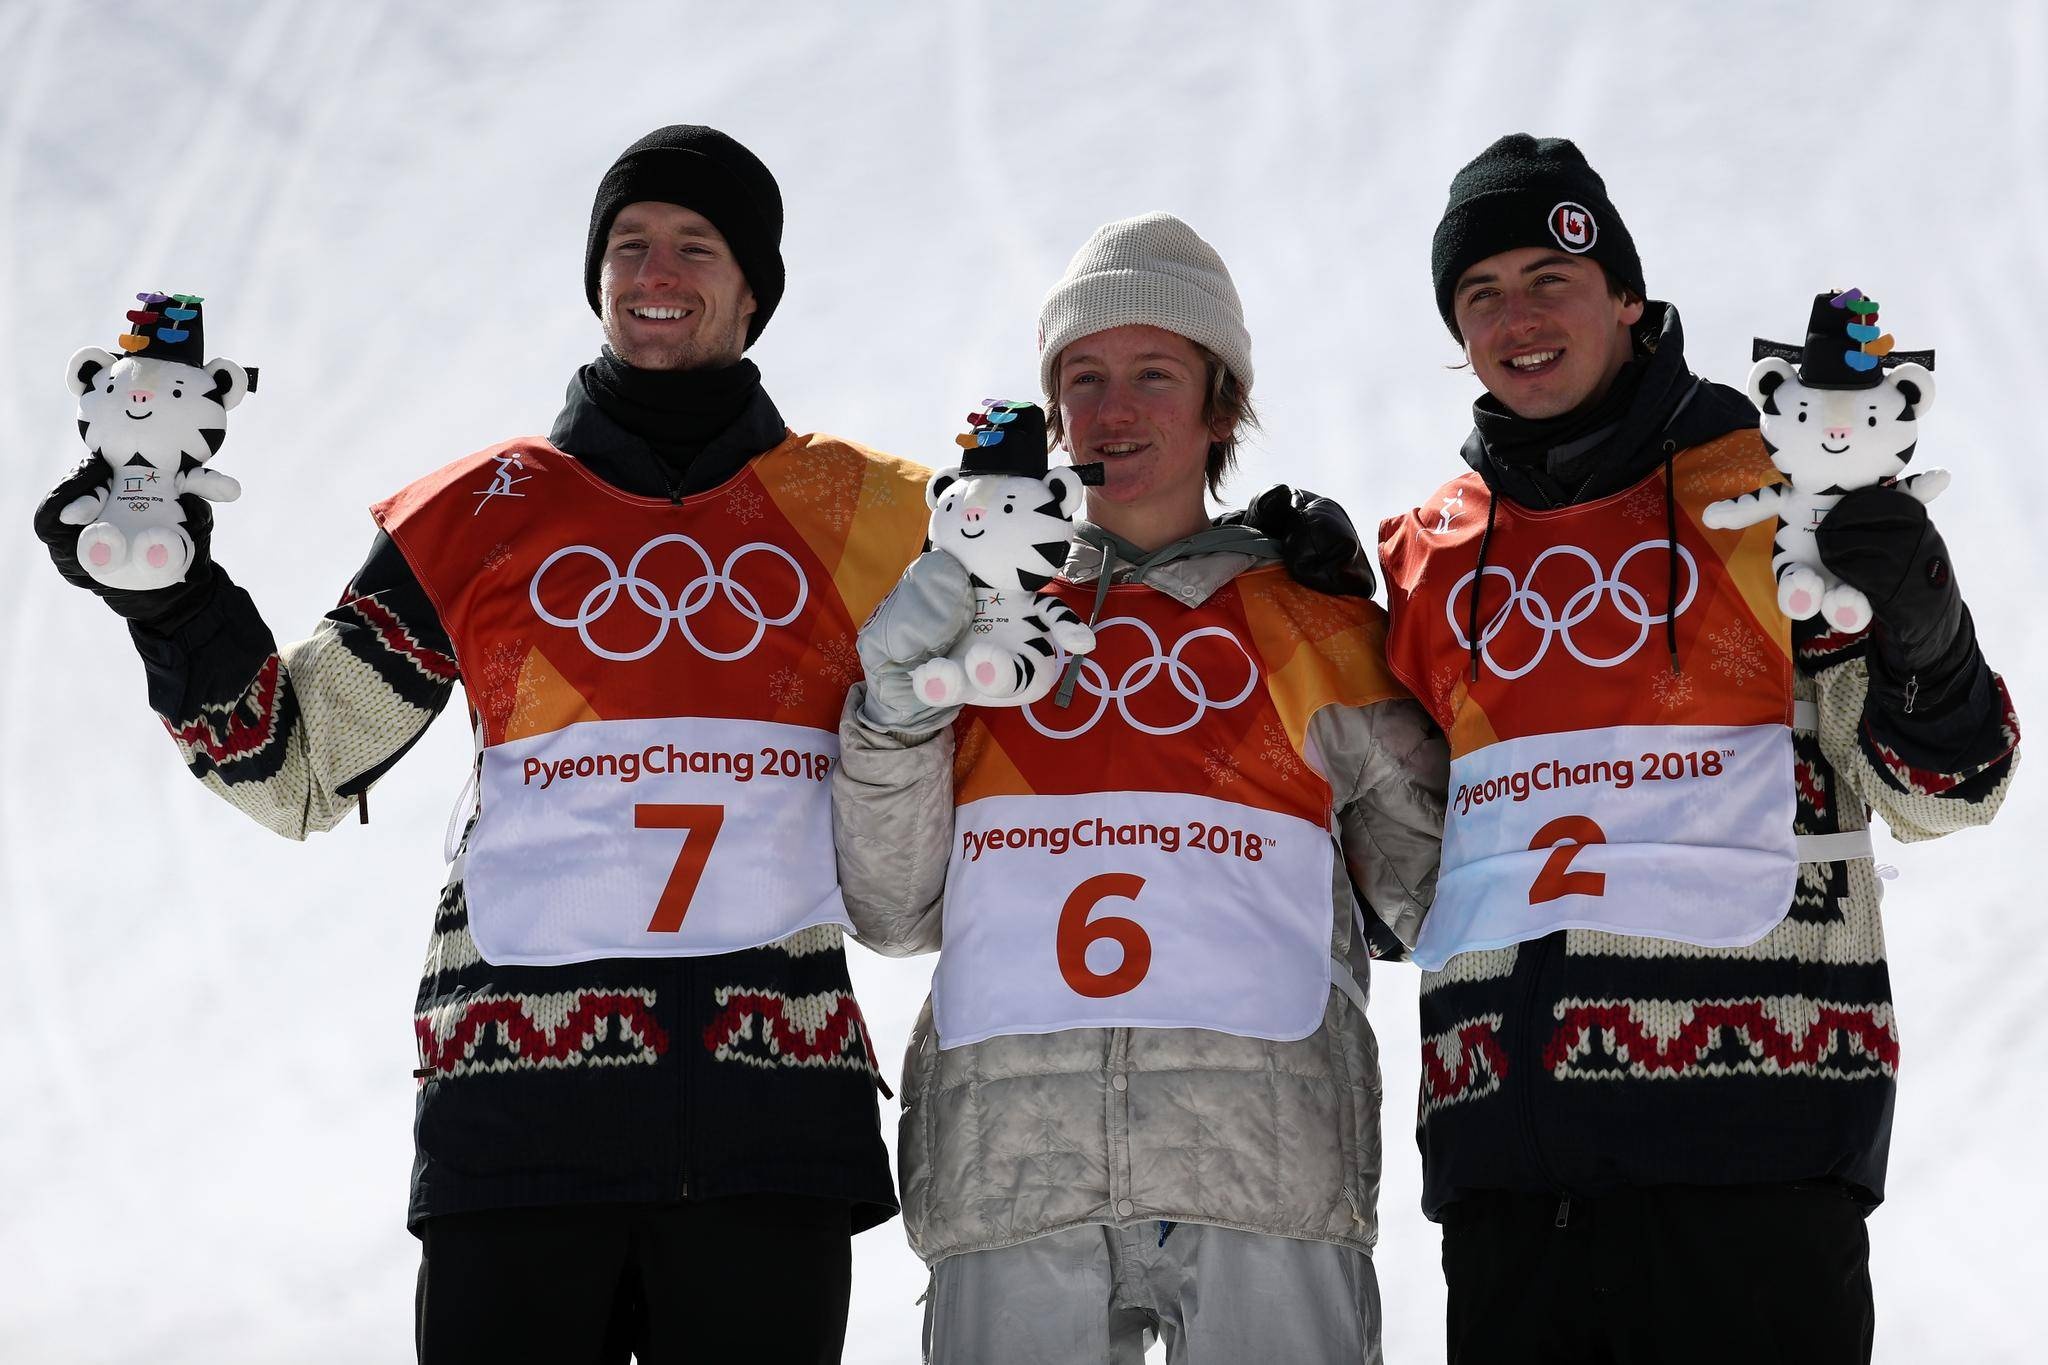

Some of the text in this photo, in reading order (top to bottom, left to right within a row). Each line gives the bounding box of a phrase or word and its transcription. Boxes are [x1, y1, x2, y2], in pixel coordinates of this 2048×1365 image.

[523, 743, 753, 790] PyeongChang
[1453, 758, 1634, 816] PyeongChang
[634, 803, 725, 933] 7
[962, 817, 1180, 862] PyeongChang
[1527, 815, 1607, 905] 2
[1056, 872, 1152, 999] 6
